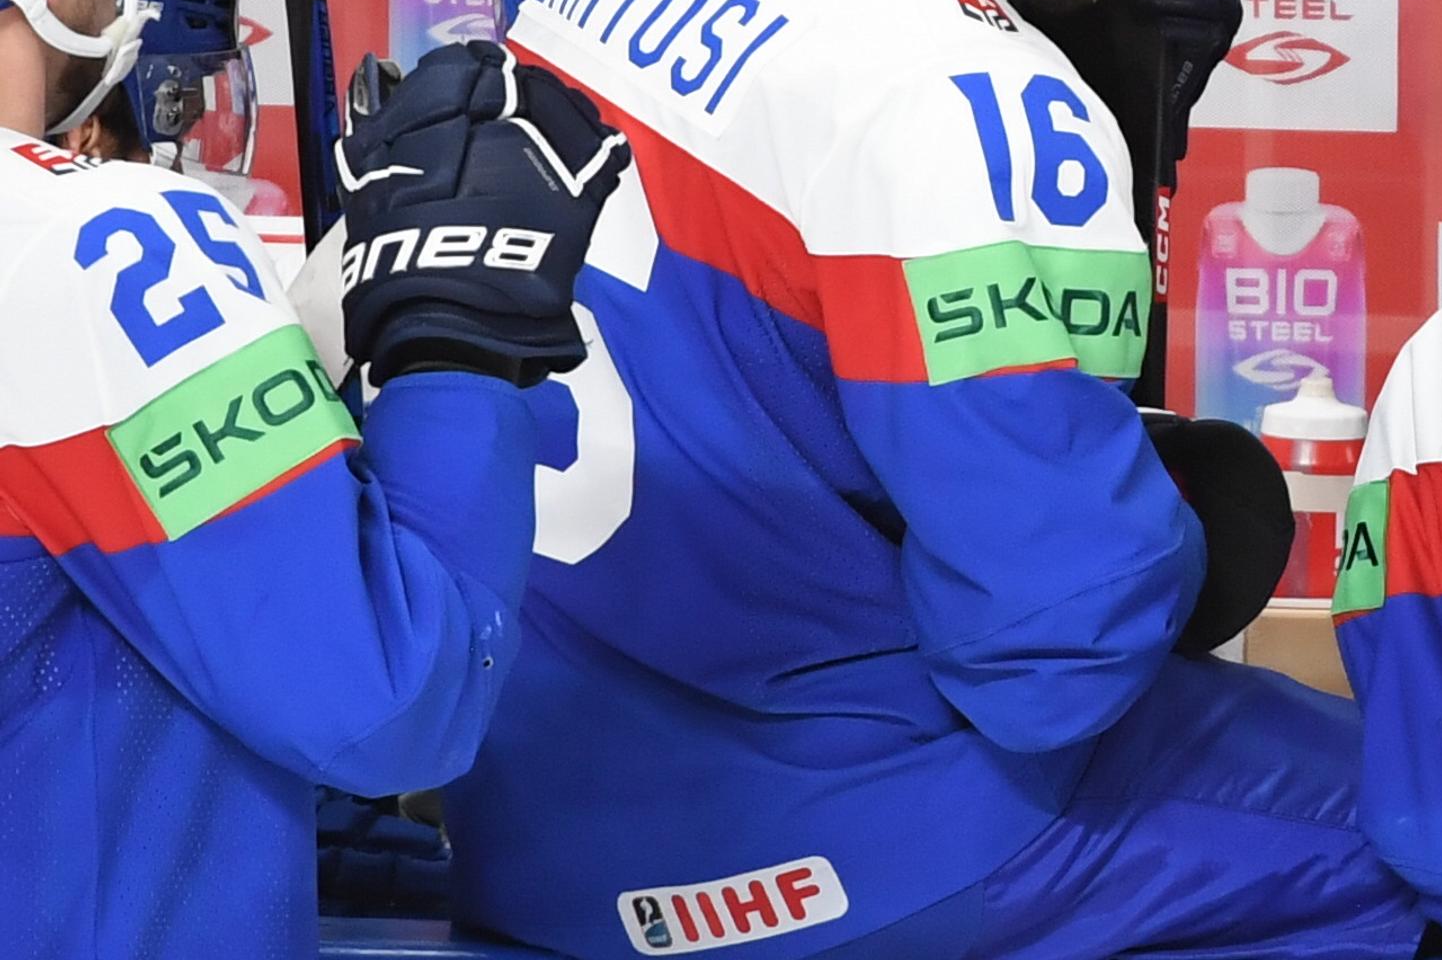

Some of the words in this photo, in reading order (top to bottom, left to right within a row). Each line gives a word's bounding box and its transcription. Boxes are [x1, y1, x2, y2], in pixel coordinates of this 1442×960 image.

[948, 71, 1108, 228] 16
[74, 189, 268, 368] 25
[1156, 195, 1171, 296] CCM
[1225, 268, 1337, 317] BIO
[1227, 320, 1334, 342] STEEL
[671, 867, 821, 943] IIHF
